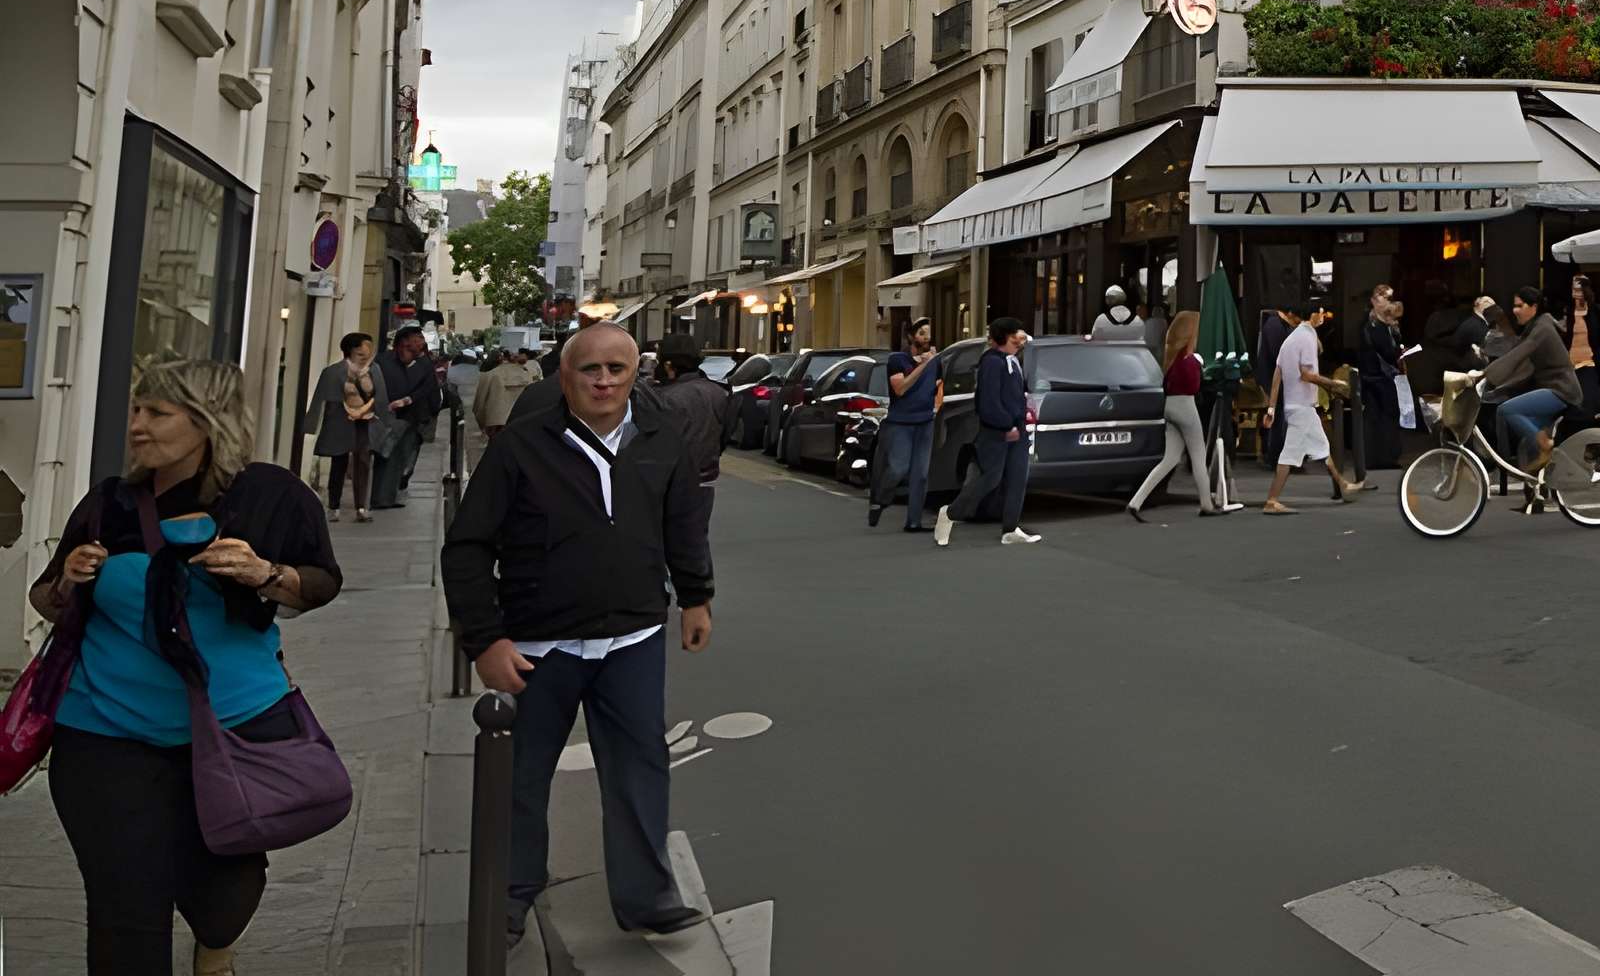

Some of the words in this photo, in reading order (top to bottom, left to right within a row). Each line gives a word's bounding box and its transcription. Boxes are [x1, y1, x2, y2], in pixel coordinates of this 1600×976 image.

[1288, 167, 1323, 184] LA
[1214, 191, 1272, 214] LA
[1301, 187, 1509, 214] PALETTE
